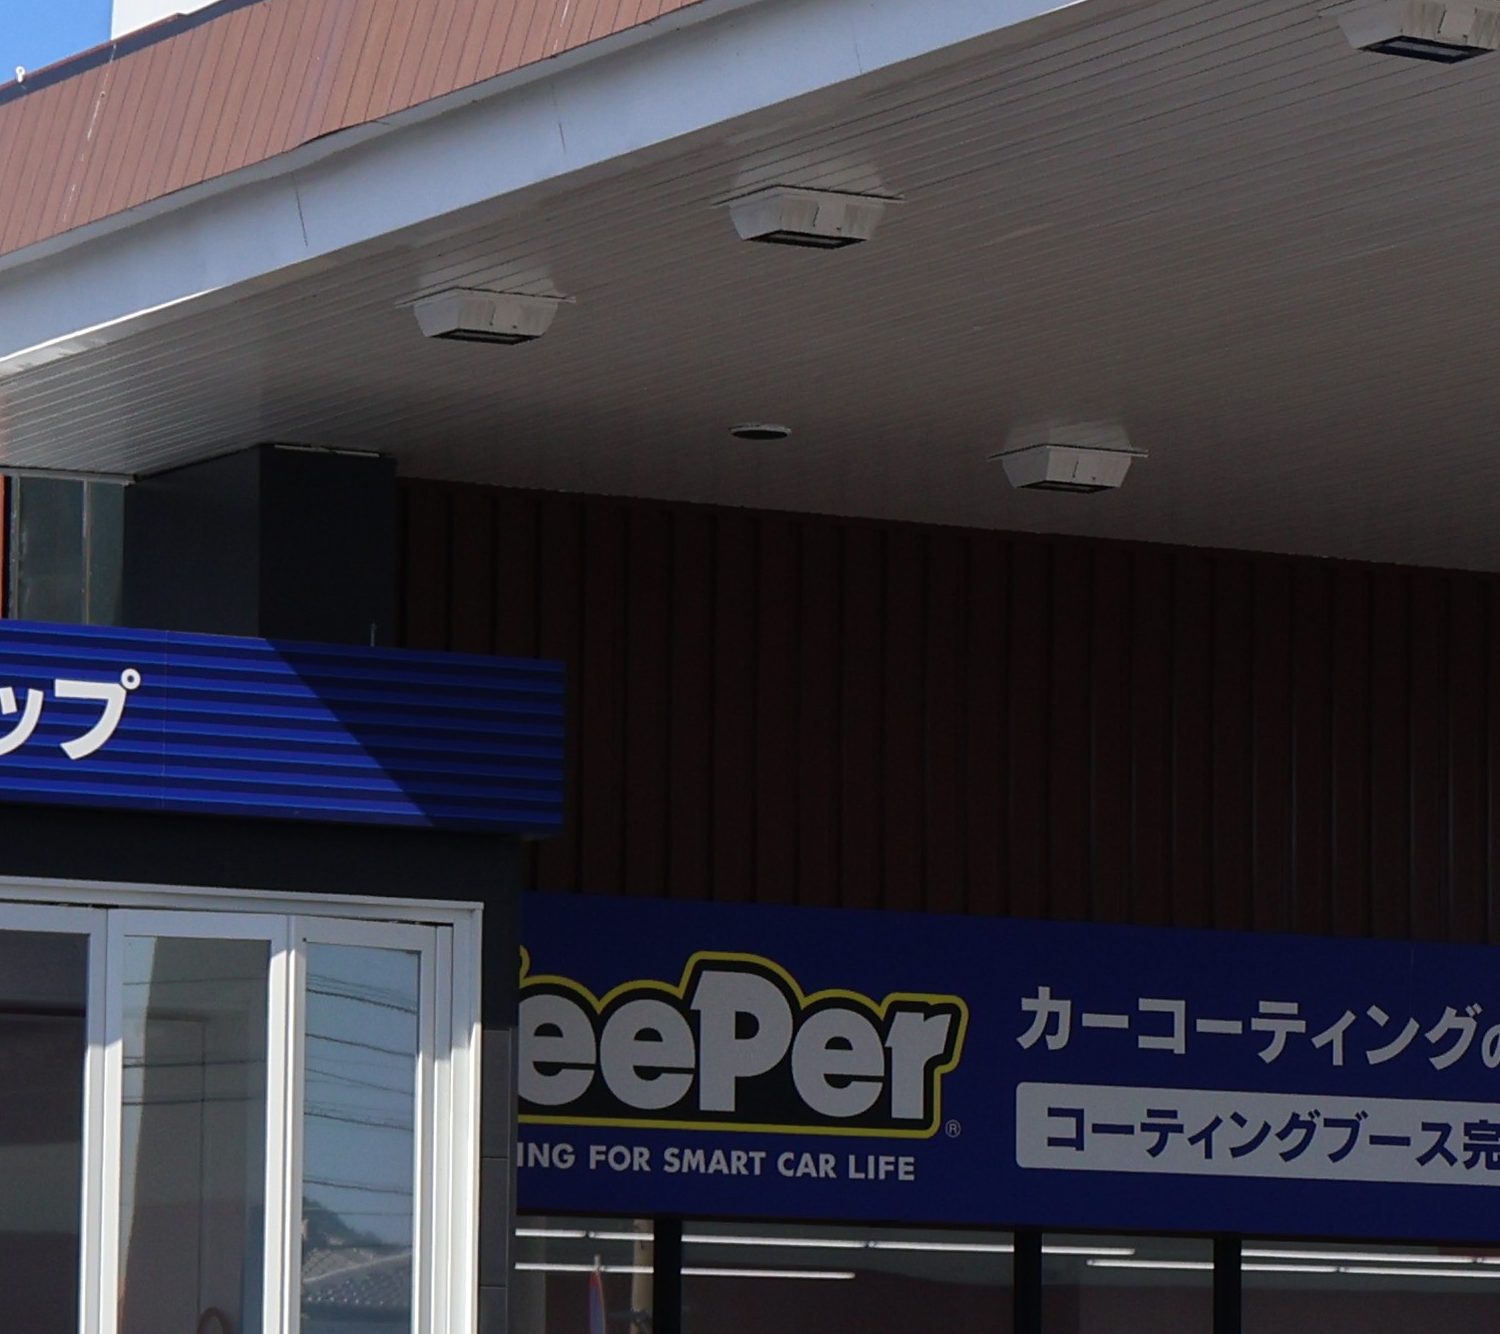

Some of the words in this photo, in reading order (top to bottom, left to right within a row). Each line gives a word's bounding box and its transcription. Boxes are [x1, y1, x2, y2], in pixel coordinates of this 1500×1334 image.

[517, 969, 952, 1119] eePer
[517, 1143, 576, 1169] ING
[589, 1144, 651, 1172] FOR
[663, 1147, 767, 1176] SMART
[776, 1151, 837, 1178] CAR
[848, 1155, 916, 1181] LIFE
